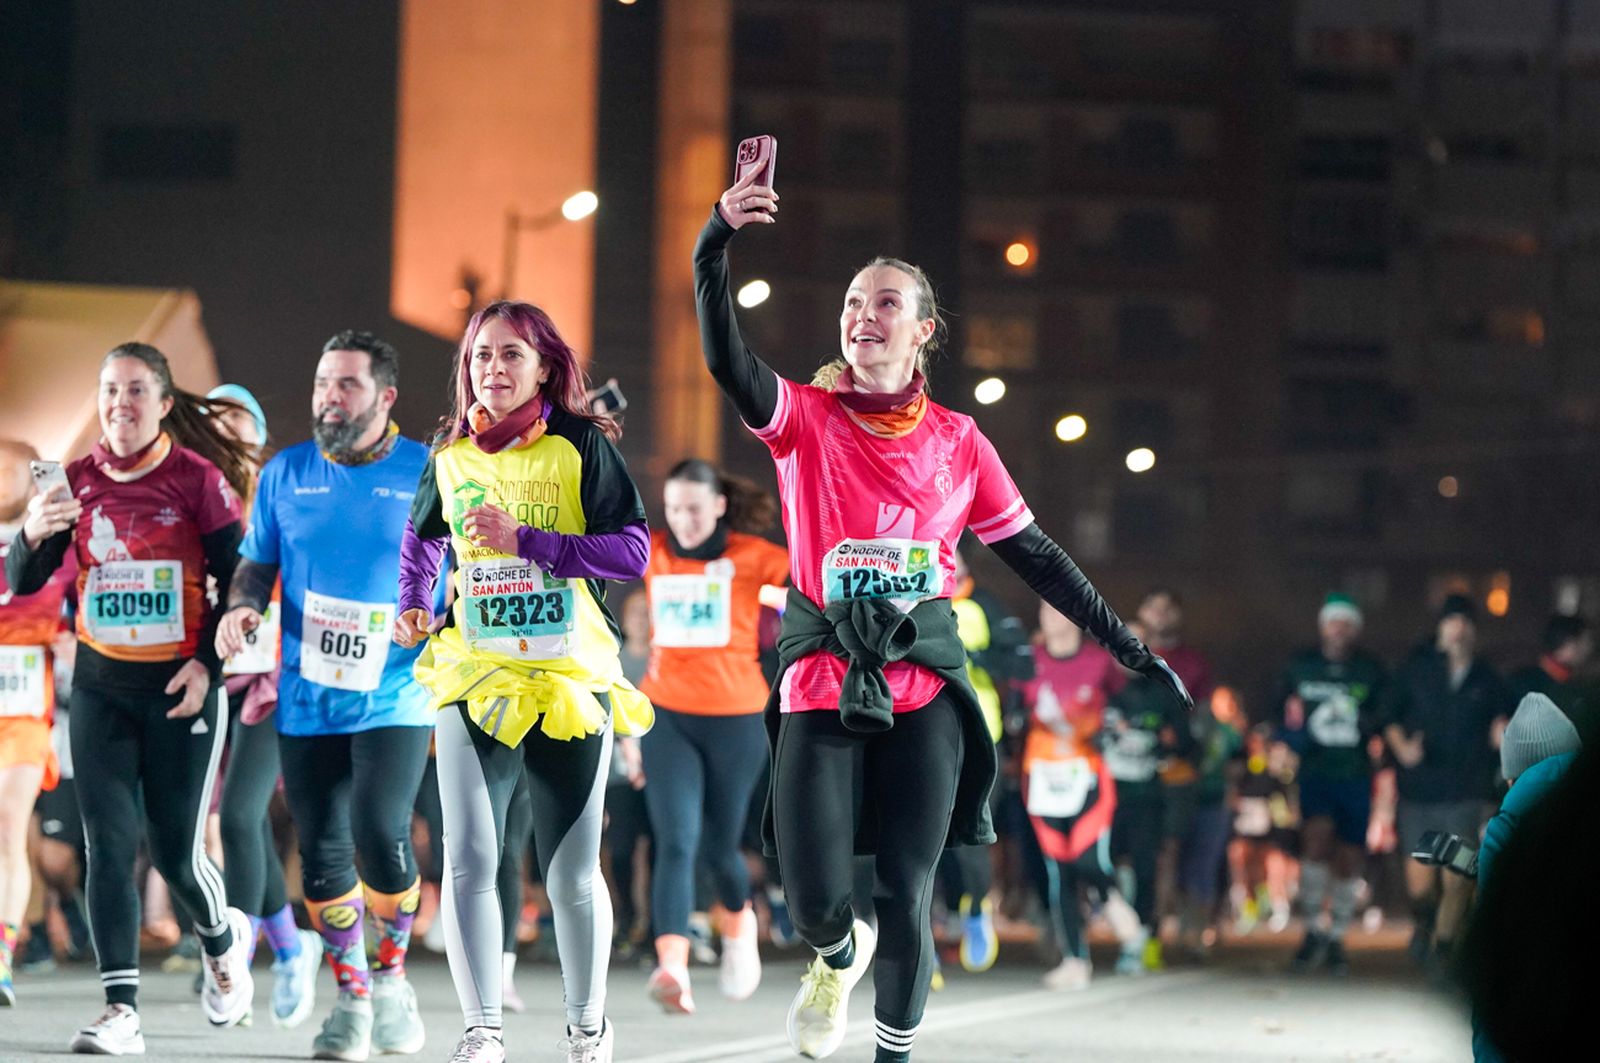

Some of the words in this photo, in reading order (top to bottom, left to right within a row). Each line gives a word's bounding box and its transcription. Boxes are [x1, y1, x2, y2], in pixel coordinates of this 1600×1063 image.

[835, 556, 860, 568] SAN
[851, 547, 887, 557] NOCHE
[887, 550, 902, 561] DE
[484, 569, 518, 582] NOCHE
[519, 568, 533, 579] DE
[472, 583, 495, 597] SAN
[496, 580, 533, 594] ANTÓN
[95, 592, 170, 618] 13090
[475, 592, 565, 627] 12323
[320, 630, 367, 660] 605
